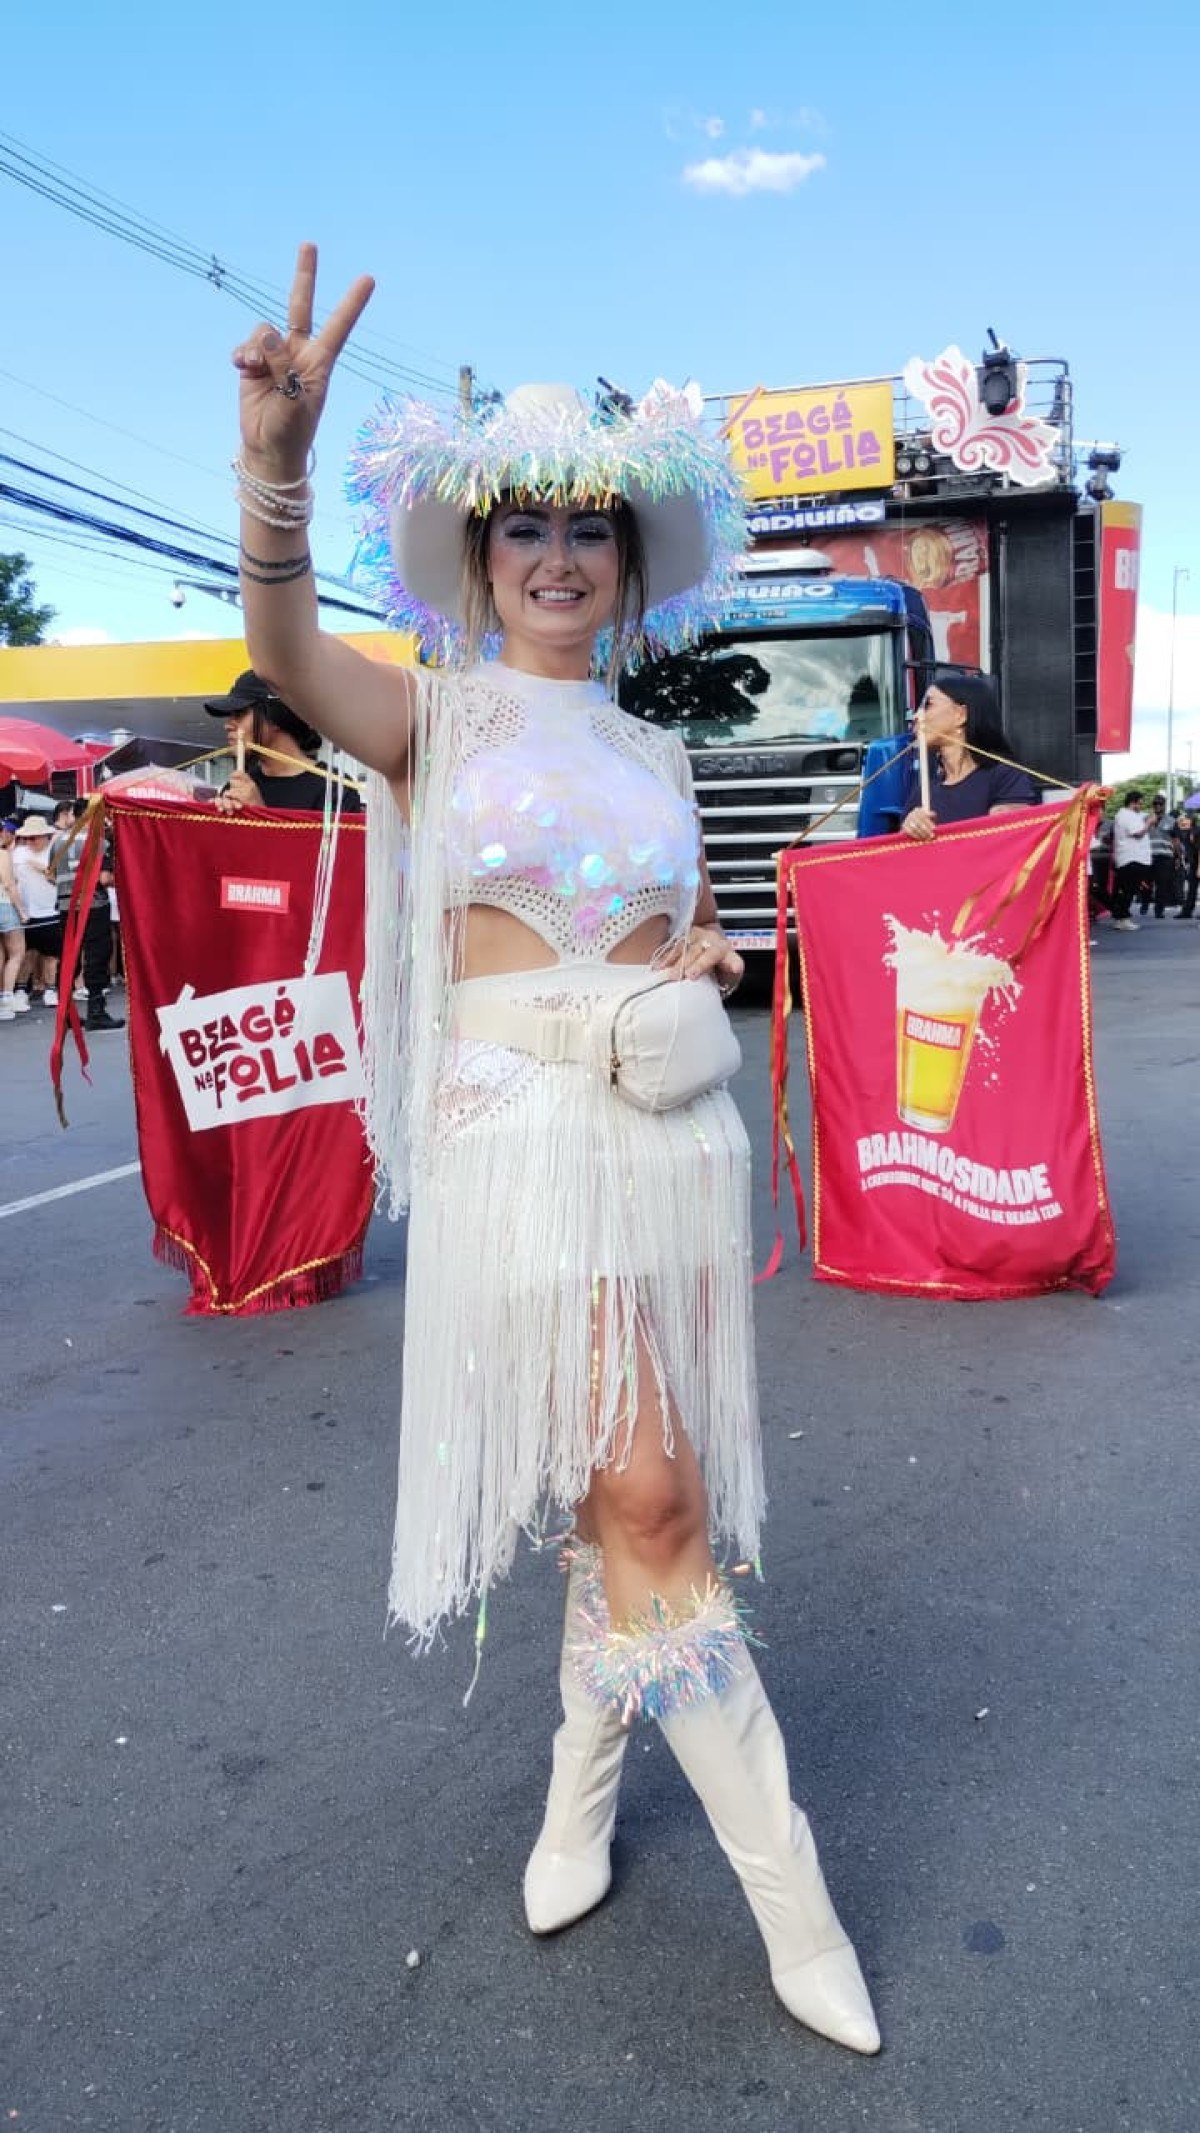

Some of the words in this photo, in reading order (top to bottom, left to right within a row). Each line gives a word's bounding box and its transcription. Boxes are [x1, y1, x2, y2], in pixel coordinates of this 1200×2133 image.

[742, 391, 853, 449] BEAGÁ
[770, 430, 881, 483] FOLIA
[227, 884, 281, 906] BRAHMA
[179, 986, 296, 1067] BEAGÁ
[906, 1012, 962, 1048] BRAHMA
[194, 1071, 214, 1091] NA
[213, 1033, 348, 1109] FOLIA
[857, 1131, 1054, 1205] BRAHMOSIDADE
[963, 1198, 991, 1221] FOLIA
